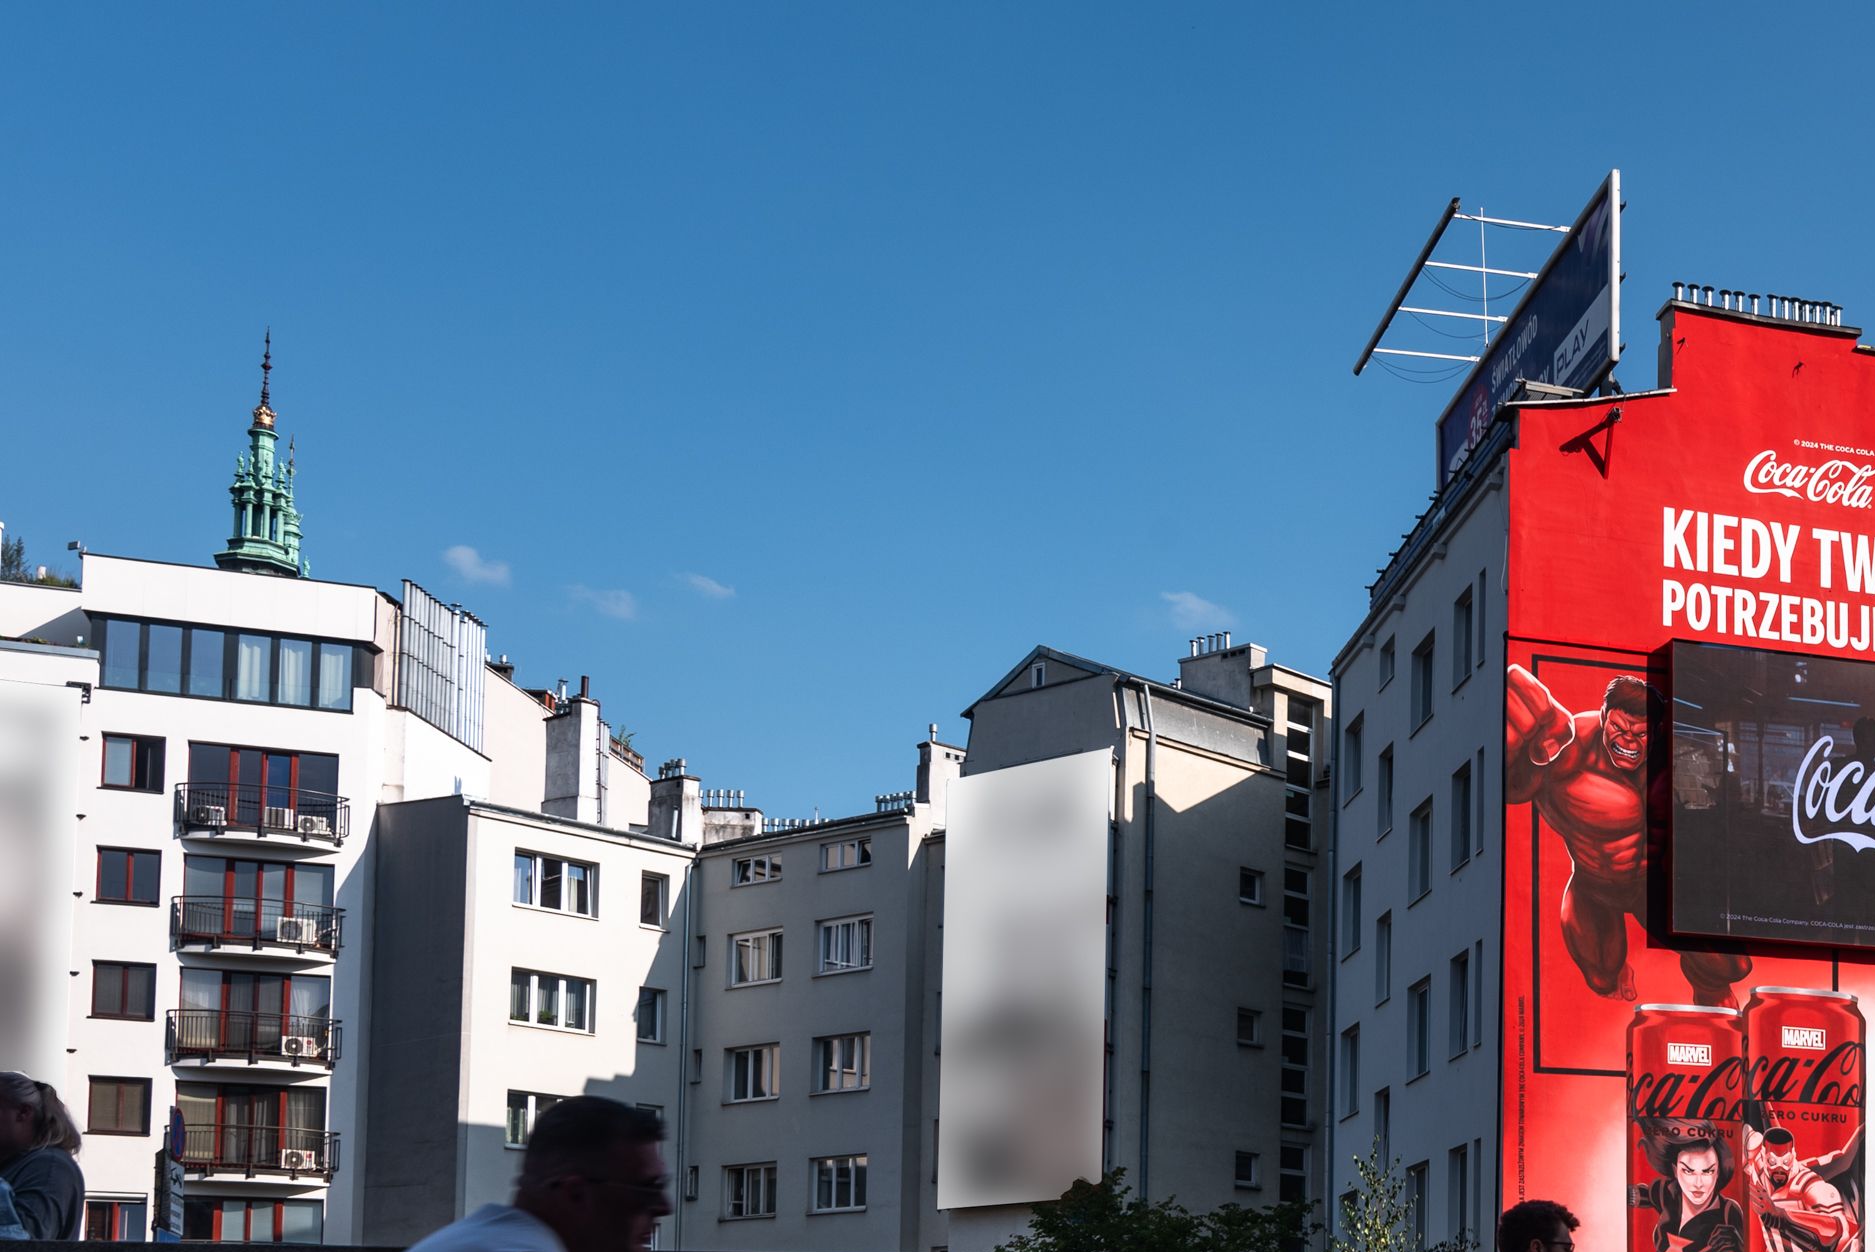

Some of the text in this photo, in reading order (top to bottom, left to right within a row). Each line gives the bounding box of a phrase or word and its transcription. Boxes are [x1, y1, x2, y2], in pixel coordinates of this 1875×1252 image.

[1492, 315, 1538, 393] ŚWIATŁOWÓD
[1556, 320, 1589, 380] PLAY
[1801, 441, 1819, 449] 2024
[1820, 443, 1835, 452] THE
[1835, 445, 1855, 454] COCA
[1856, 448, 1875, 457] COLA
[1663, 507, 1801, 583] KIEDY
[1784, 1029, 1824, 1047] MARVEL
[1669, 1045, 1709, 1063] MARVEL
[1801, 1111, 1847, 1123] CUKRU
[1687, 1127, 1734, 1138] CUKRU
